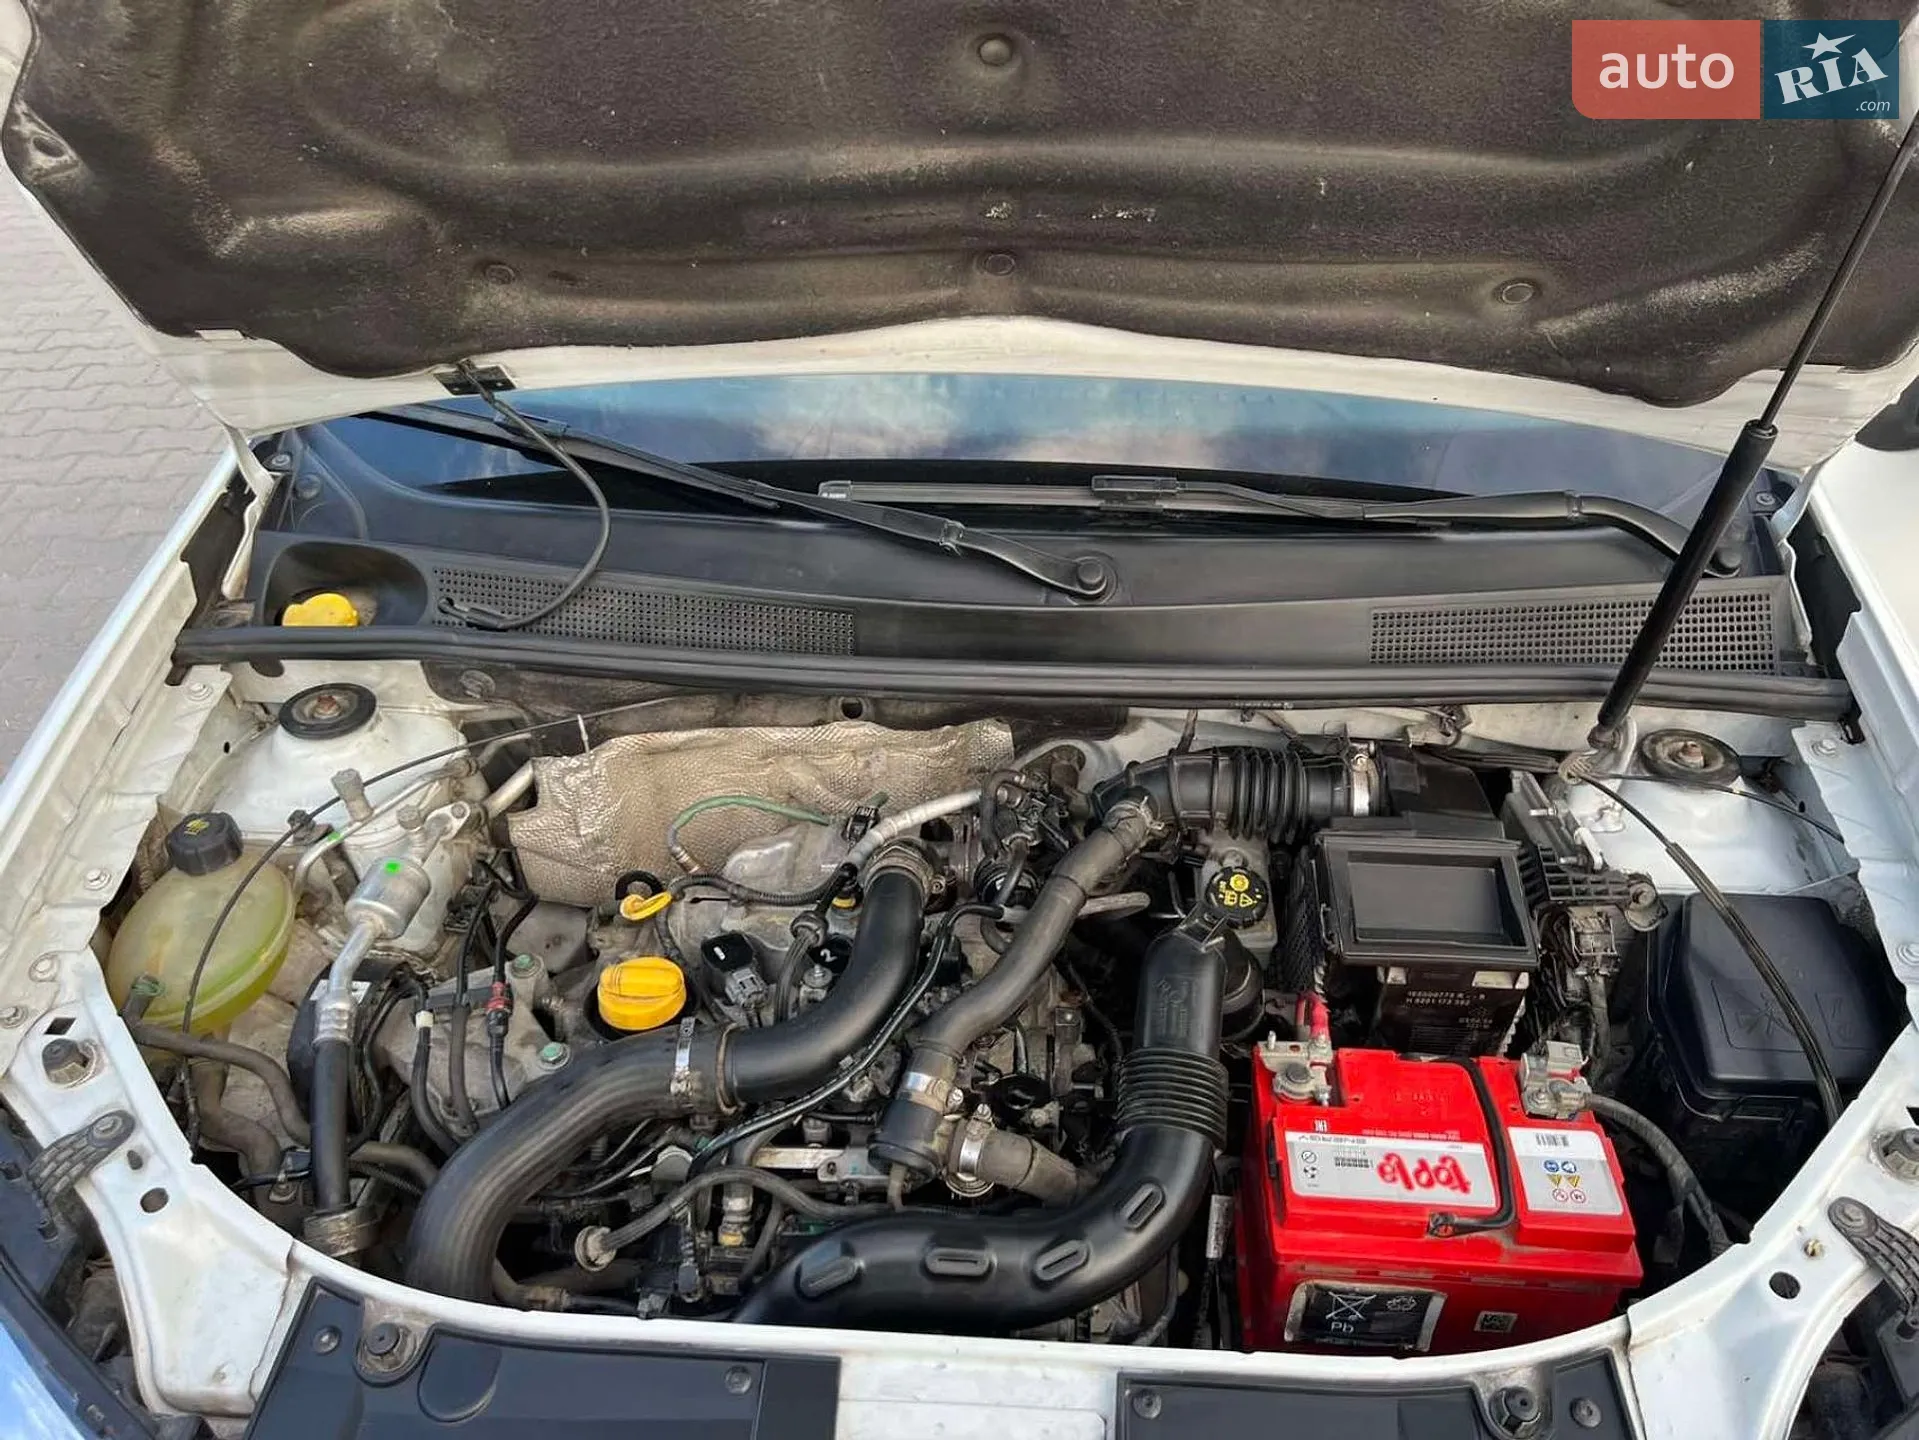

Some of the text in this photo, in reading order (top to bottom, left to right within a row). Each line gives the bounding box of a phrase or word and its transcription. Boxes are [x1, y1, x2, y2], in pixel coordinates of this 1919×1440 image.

[820, 948, 838, 963] 2
[1376, 1152, 1472, 1195] topla
[1331, 1321, 1354, 1334] Pb
